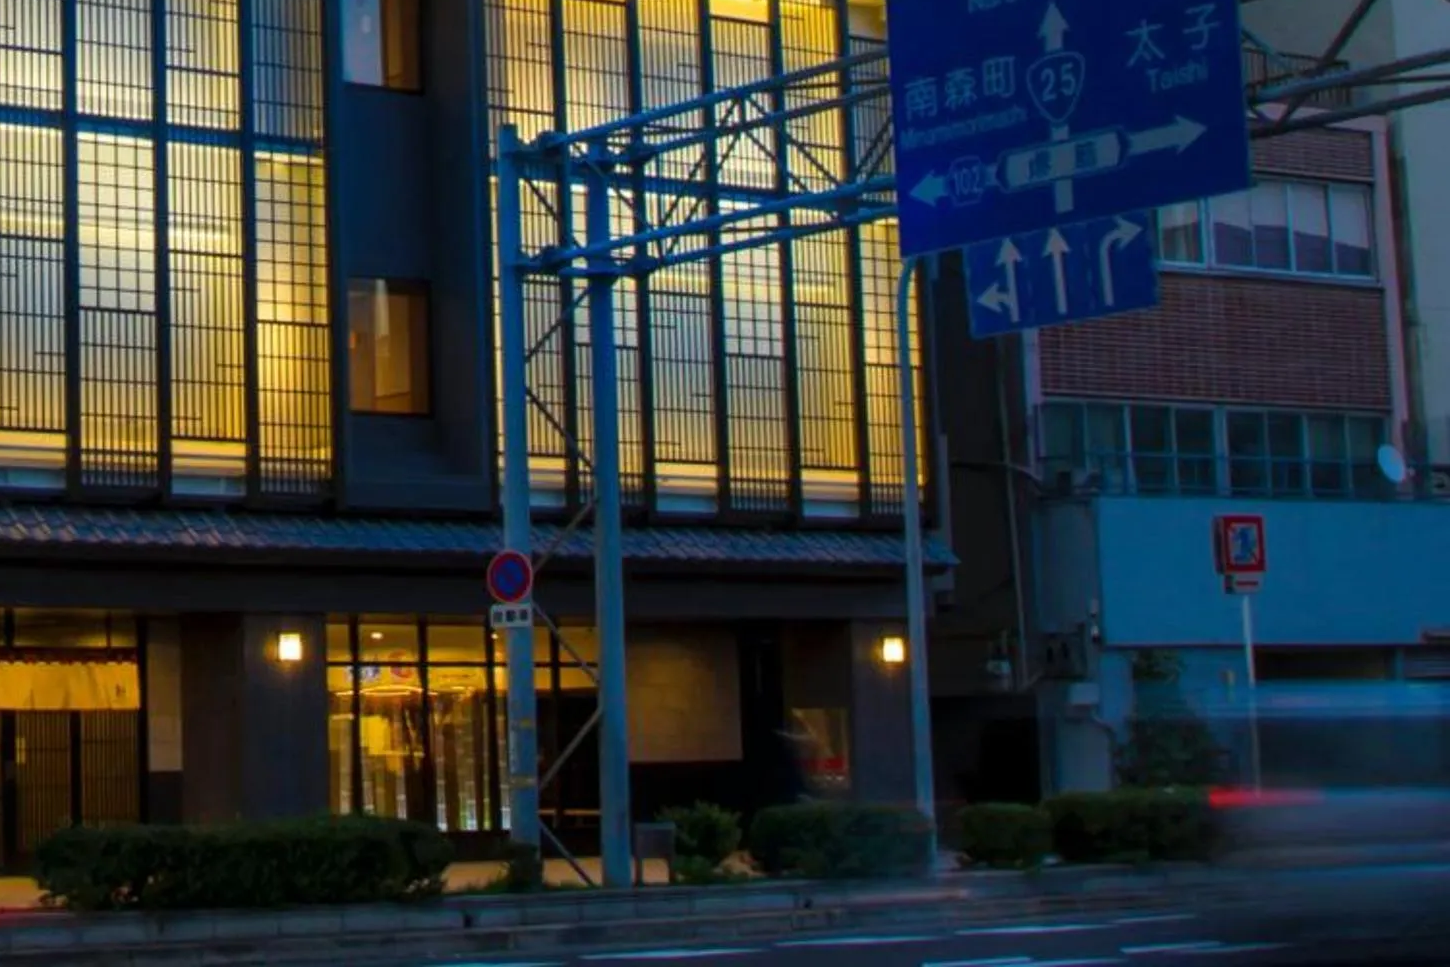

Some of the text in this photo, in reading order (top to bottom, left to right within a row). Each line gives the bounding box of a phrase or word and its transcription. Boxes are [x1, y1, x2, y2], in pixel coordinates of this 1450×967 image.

[1123, 2, 1220, 68] 太子
[1040, 62, 1077, 102] 25
[952, 165, 984, 196] 102
